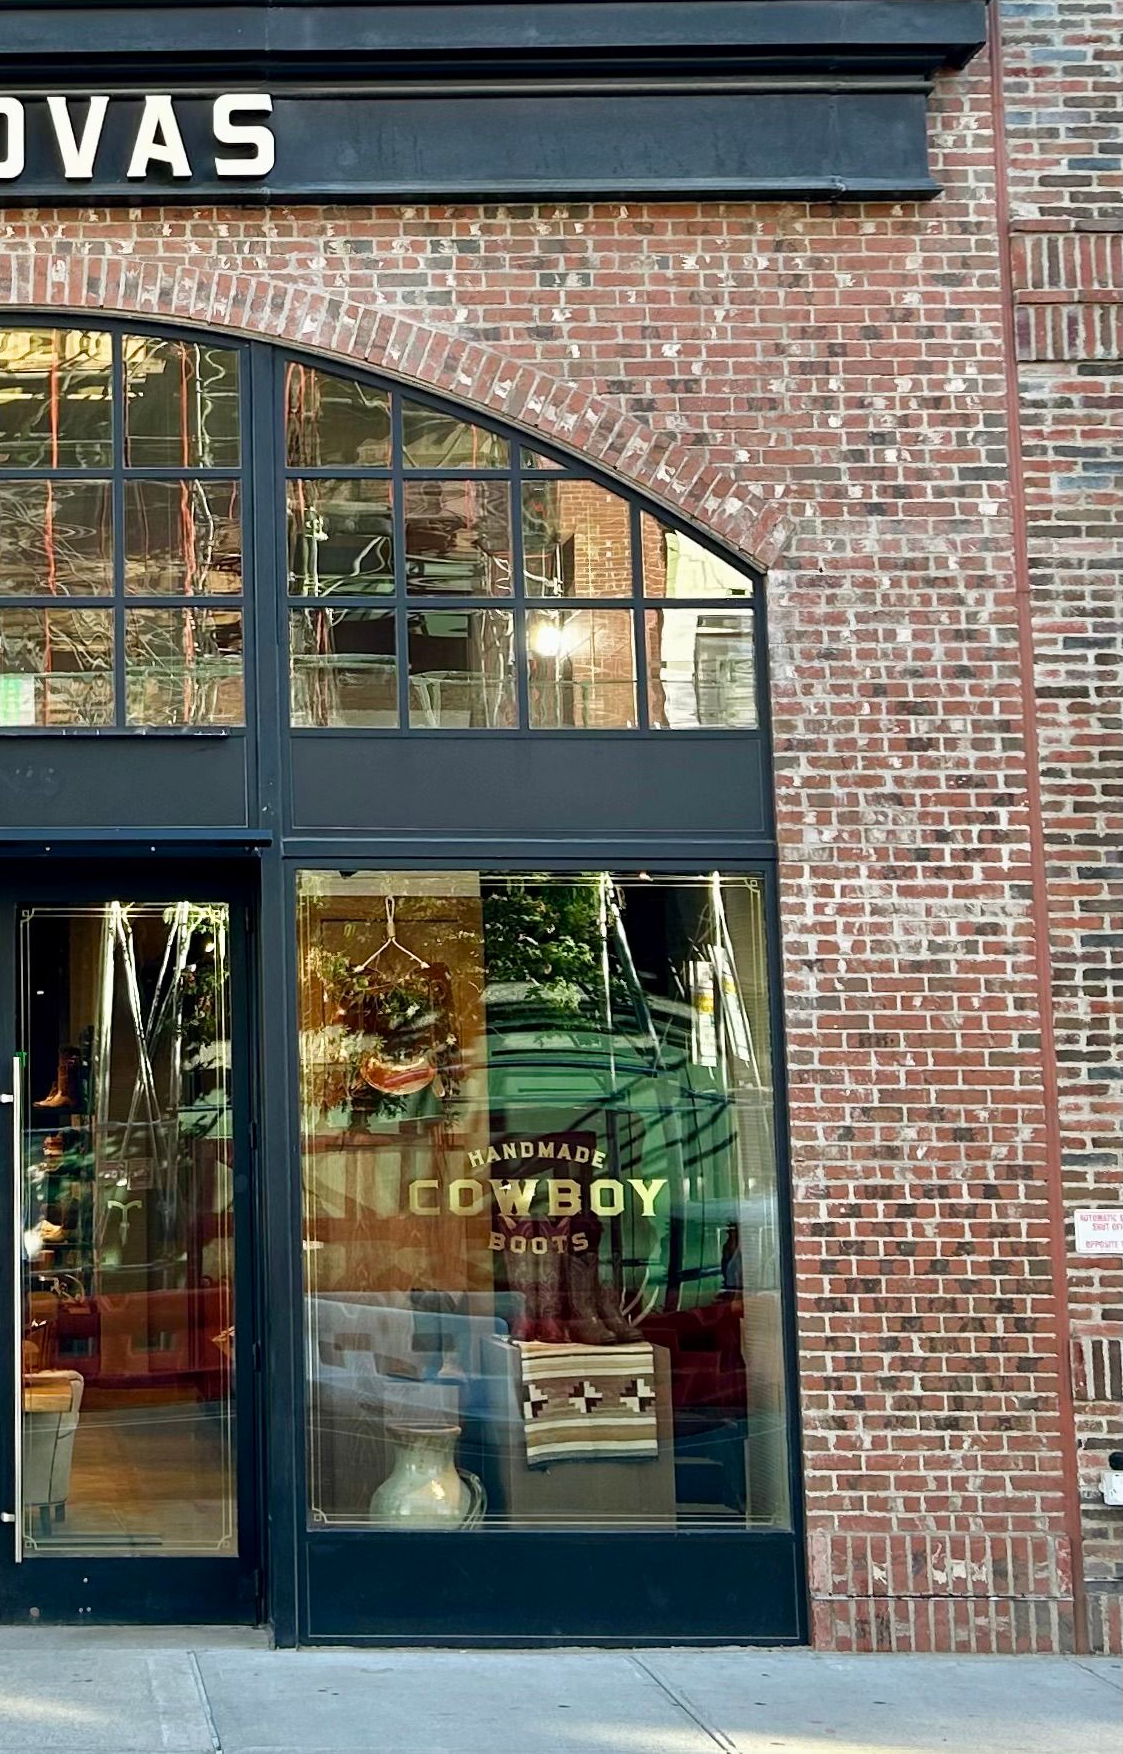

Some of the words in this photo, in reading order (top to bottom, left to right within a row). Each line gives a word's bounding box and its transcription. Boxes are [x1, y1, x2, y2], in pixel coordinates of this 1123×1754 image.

[467, 1141, 607, 1169] HANDMADE
[408, 1178, 669, 1217] COWBOY
[487, 1231, 589, 1255] BOOTS
